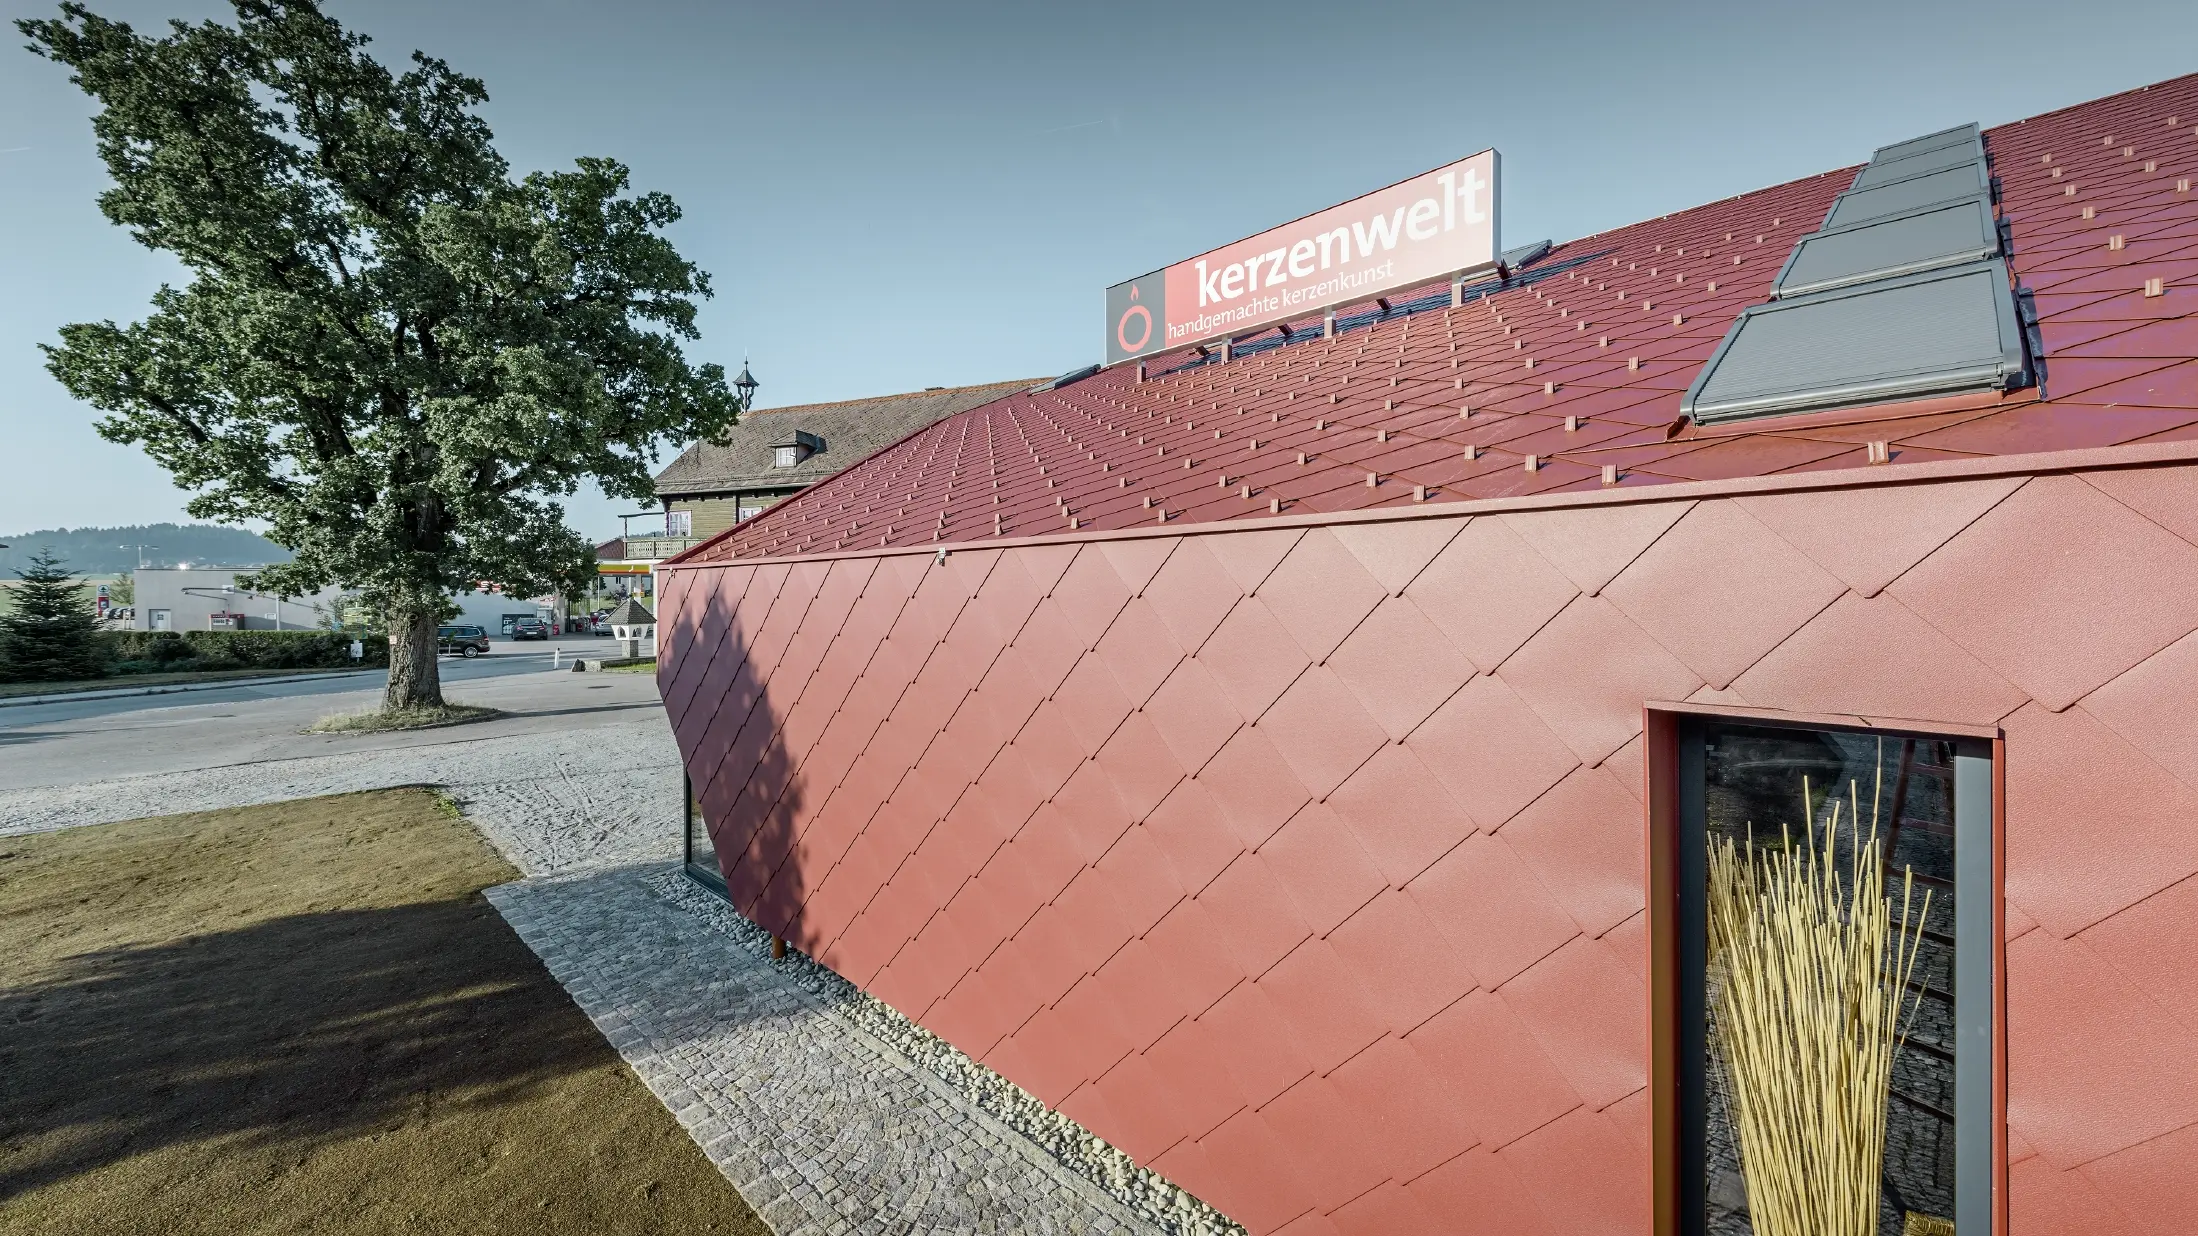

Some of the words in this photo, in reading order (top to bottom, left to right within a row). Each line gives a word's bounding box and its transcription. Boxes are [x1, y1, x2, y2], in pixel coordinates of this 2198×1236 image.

[1195, 168, 1486, 307] kerzenwelt
[1167, 298, 1279, 339] handgemachte
[1281, 260, 1394, 307] kerzenkunst
